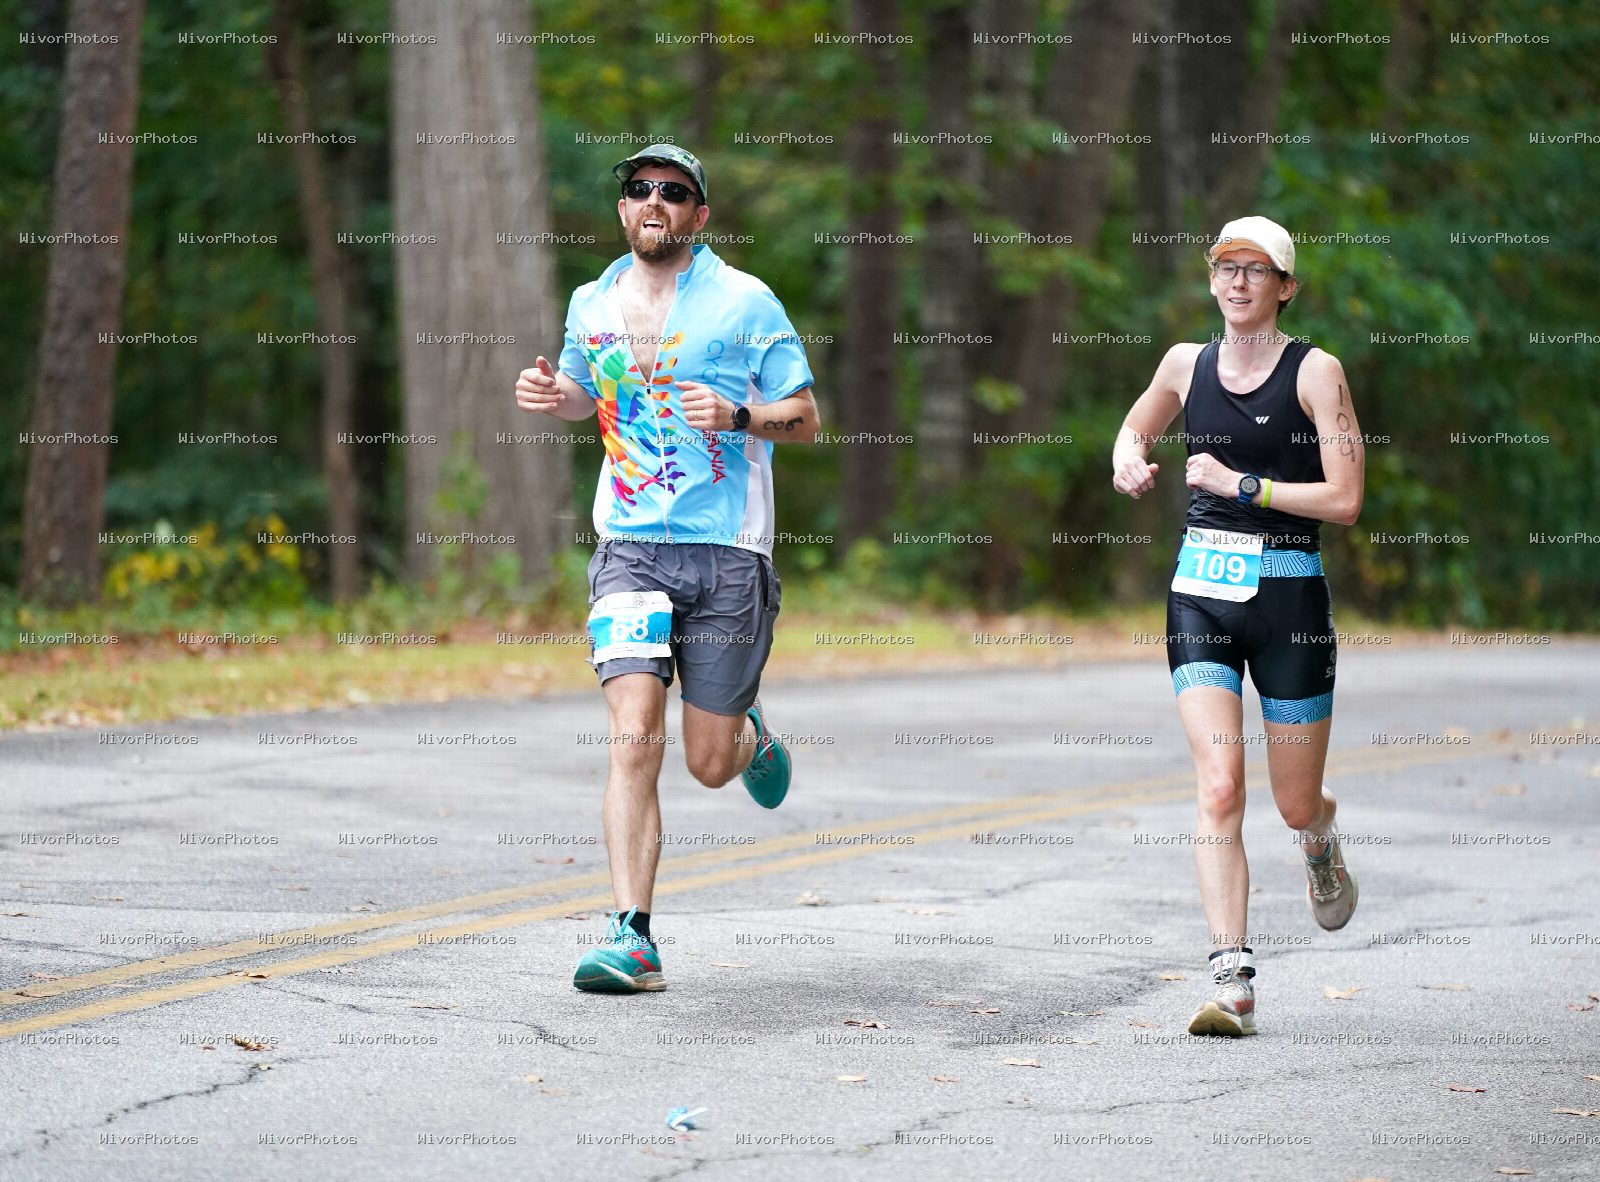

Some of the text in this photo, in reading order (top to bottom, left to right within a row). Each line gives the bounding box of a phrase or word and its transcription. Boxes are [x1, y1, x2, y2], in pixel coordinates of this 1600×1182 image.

[1336, 384, 1355, 462] 109
[1193, 551, 1246, 583] 109
[611, 615, 649, 641] 68
